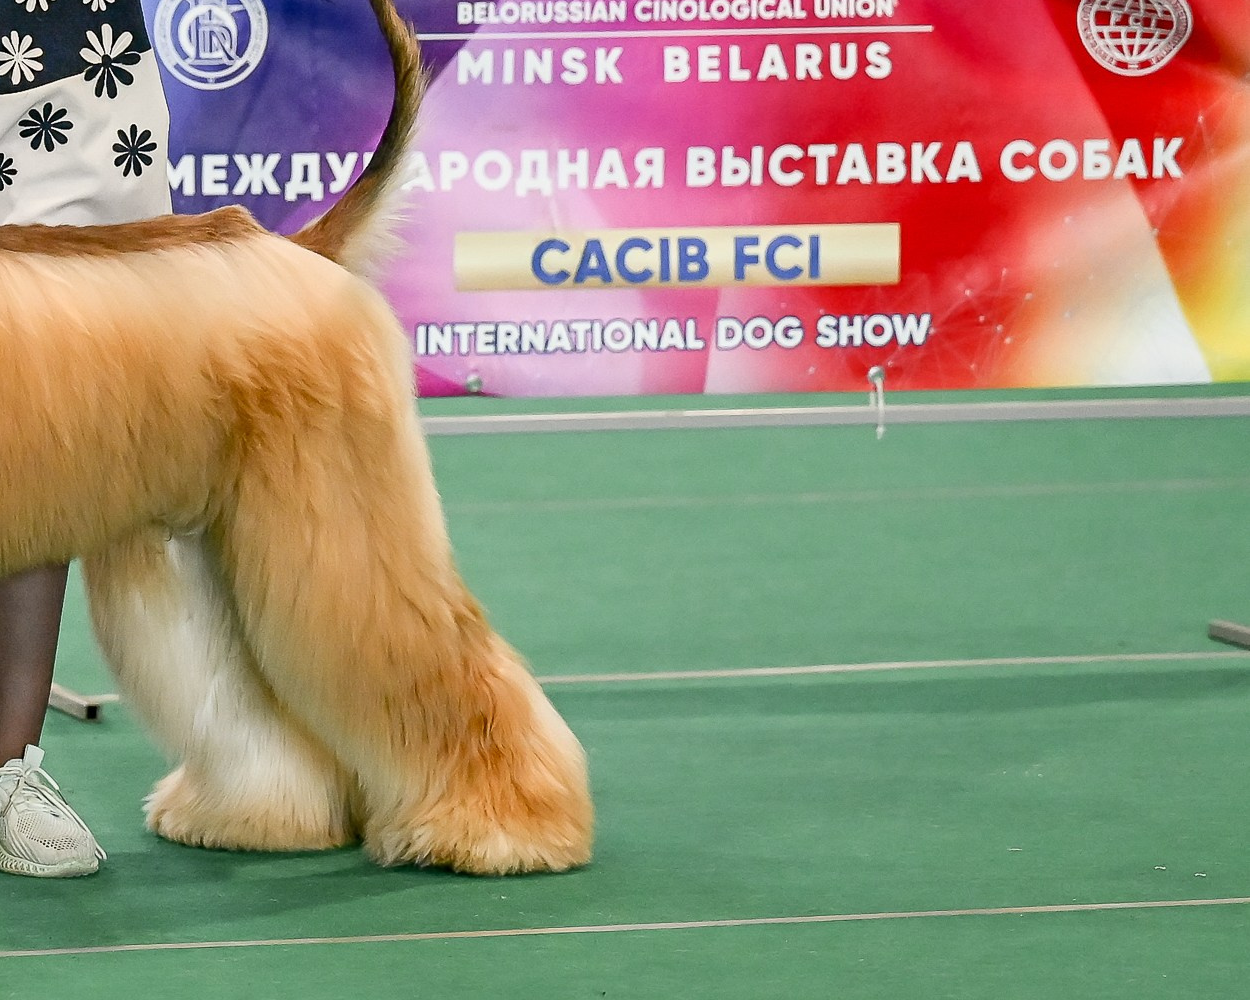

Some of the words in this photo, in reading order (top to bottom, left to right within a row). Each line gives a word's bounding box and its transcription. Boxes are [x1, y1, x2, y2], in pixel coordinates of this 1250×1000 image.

[456, 0, 628, 26] BELORUSSIAN
[456, 46, 625, 86] MINSK
[663, 39, 893, 82] BELARUS
[167, 146, 666, 202] МЕЖДУАРОДНАЯ
[685, 140, 984, 188] ВЫСТАВКА
[998, 136, 1185, 182] СОБАК
[530, 236, 711, 286] CACIB
[733, 233, 822, 282] FCI
[414, 317, 706, 357] INTERNATIONAL
[715, 314, 805, 352] DOG
[814, 312, 932, 349] SHOW
